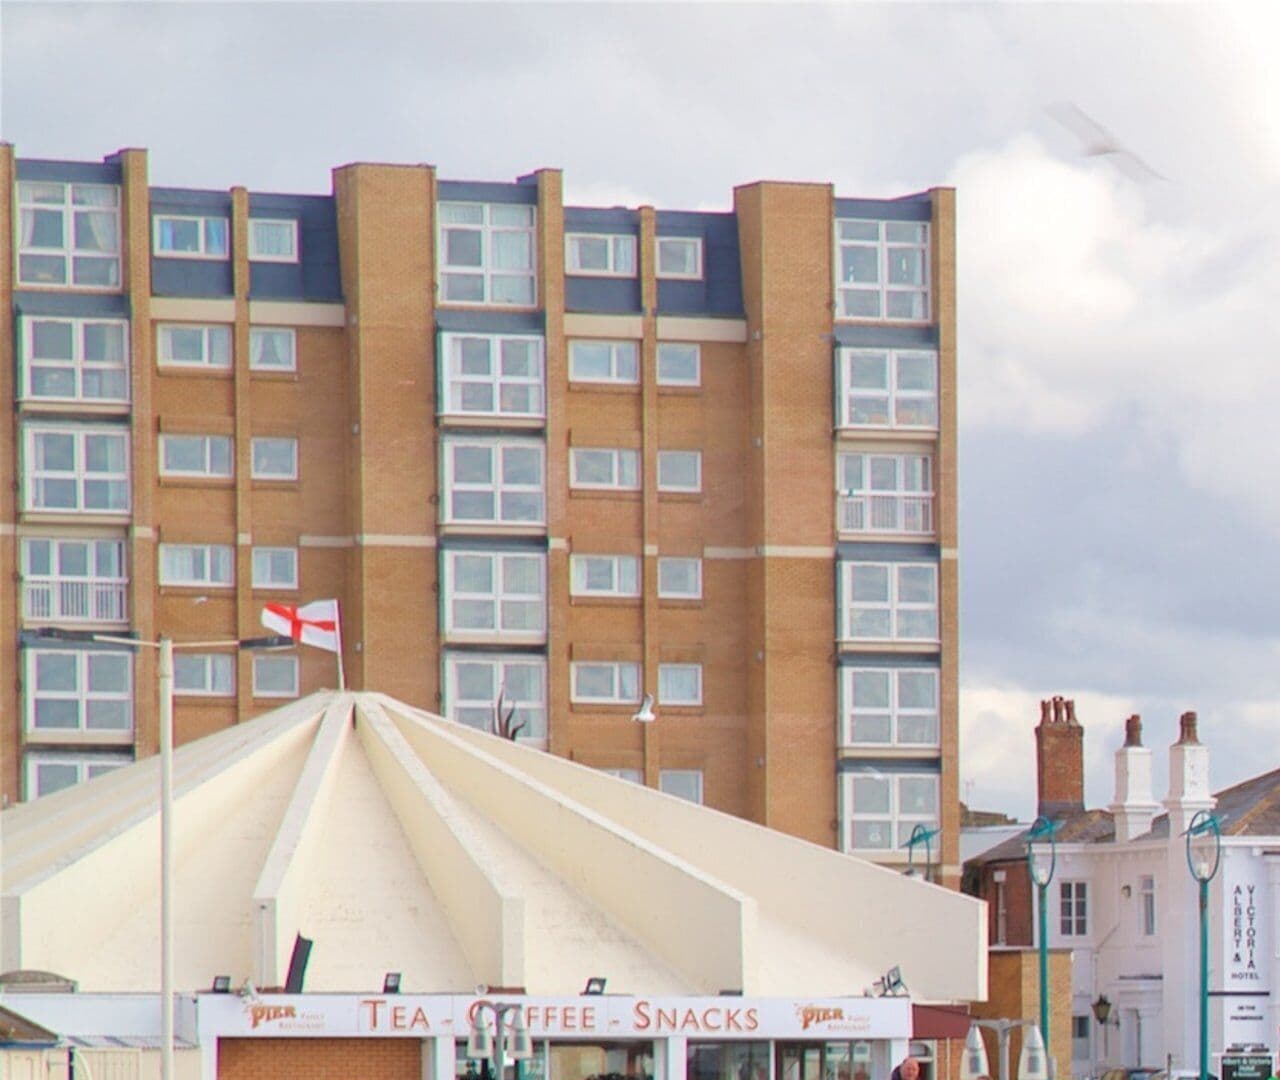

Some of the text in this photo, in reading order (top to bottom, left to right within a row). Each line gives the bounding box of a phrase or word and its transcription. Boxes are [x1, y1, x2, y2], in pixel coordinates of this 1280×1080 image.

[1246, 885, 1256, 969] VICTORIA
[1231, 972, 1259, 980] HOTEL
[361, 1000, 430, 1029] TEA
[467, 1000, 595, 1029] CFFEE
[634, 1001, 760, 1032] SNACKS
